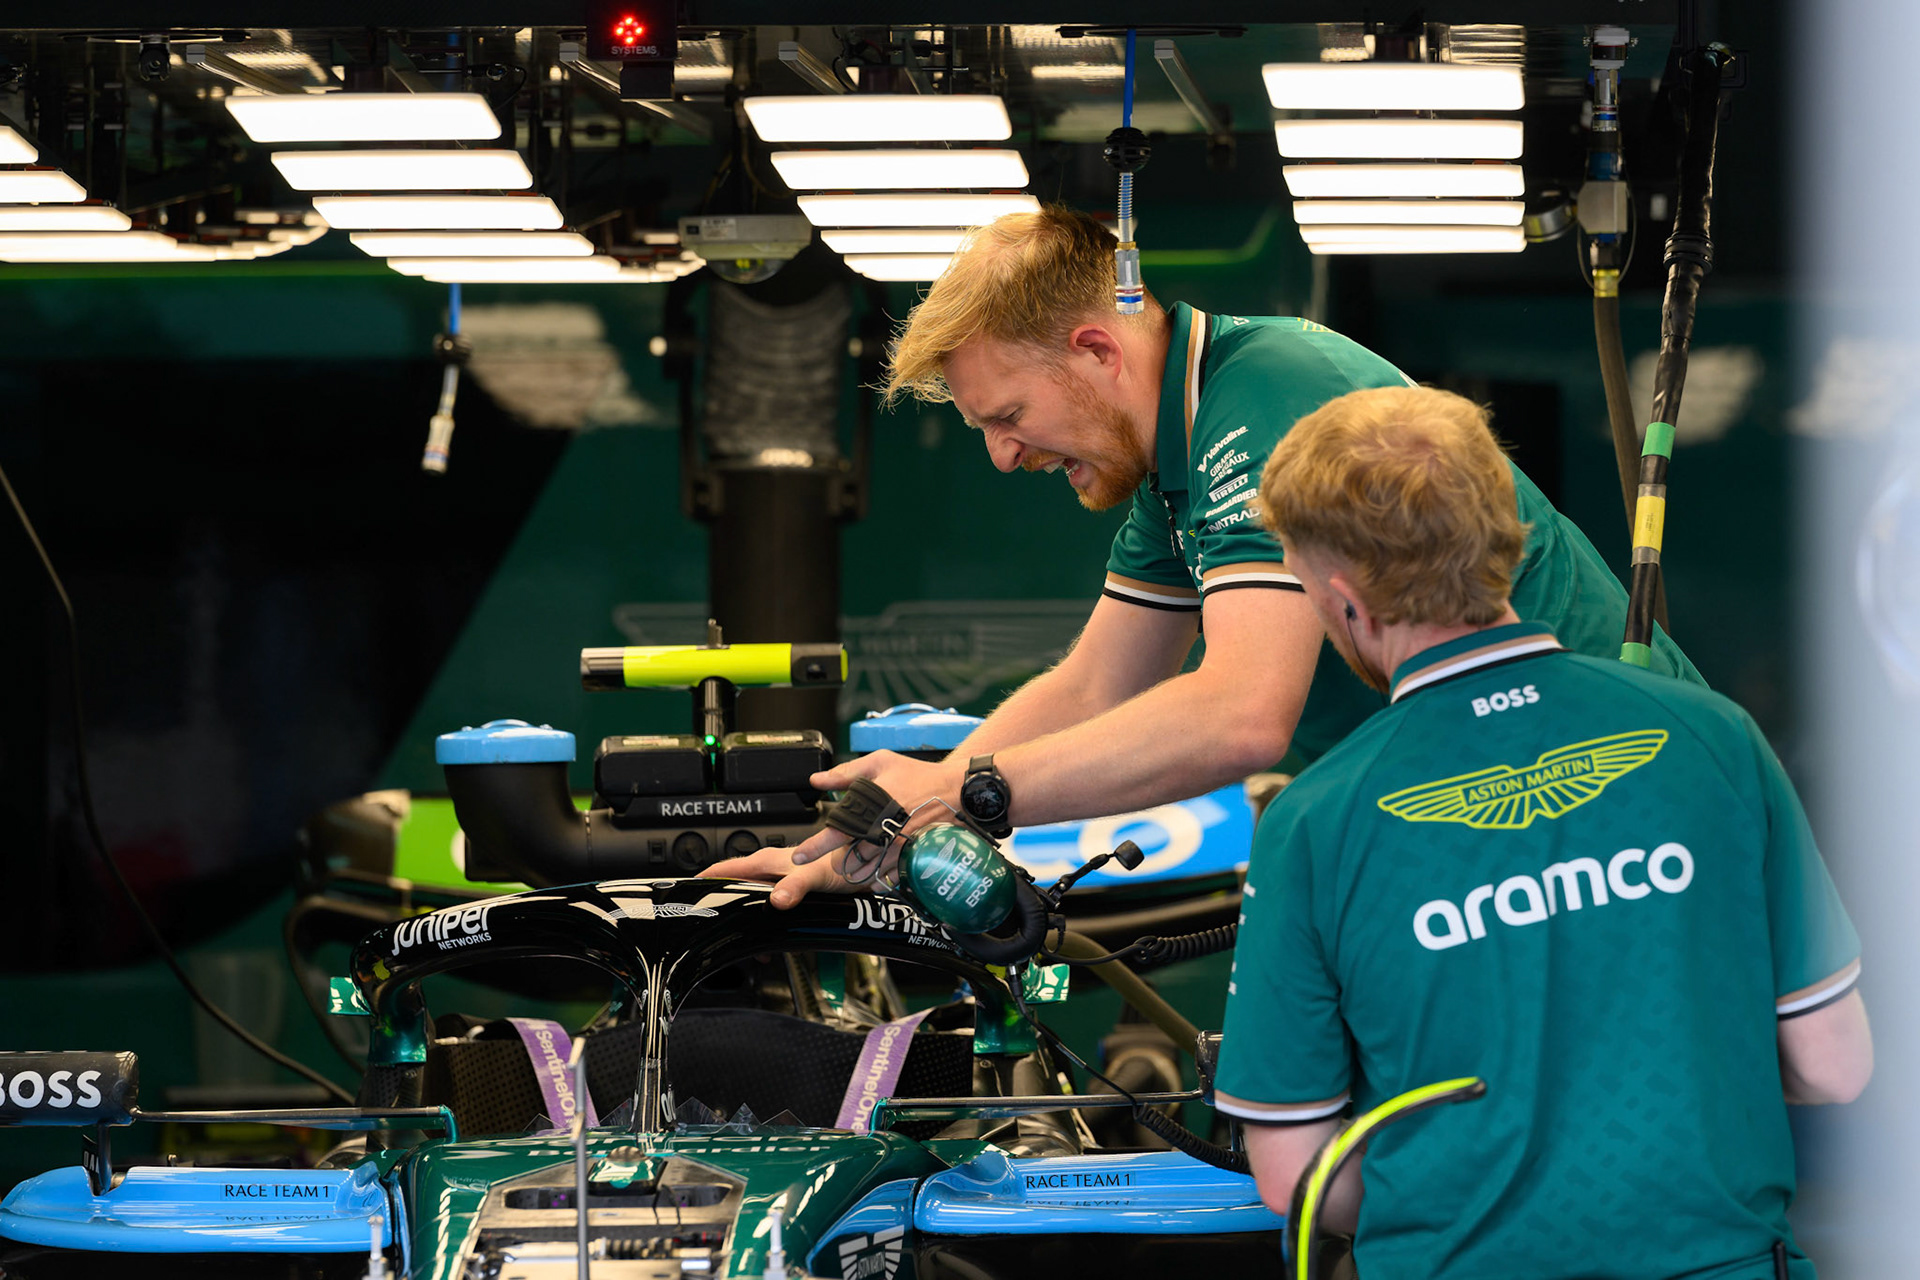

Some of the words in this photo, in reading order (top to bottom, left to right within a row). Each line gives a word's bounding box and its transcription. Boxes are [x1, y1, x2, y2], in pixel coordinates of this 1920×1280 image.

[611, 46, 657, 55] SYSTEMS
[1207, 426, 1248, 459] Valvoline
[1210, 449, 1235, 477] GIRARD
[1208, 474, 1248, 502] PIRELLI
[1471, 684, 1540, 717] BOSS
[1467, 776, 1524, 804] ASTON
[1526, 757, 1591, 790] MARTIN
[661, 802, 703, 816] RACE
[705, 800, 752, 815] TEAM
[754, 799, 761, 812] 1
[937, 850, 976, 896] aramco
[965, 876, 993, 907] EPOS
[1413, 842, 1694, 950] aramco
[438, 932, 492, 950] NETWORKS
[0, 1070, 102, 1109] OSS
[535, 1029, 578, 1124] SentinelO
[850, 1026, 901, 1131] SentinelOne
[225, 1184, 268, 1197] RACE
[272, 1184, 318, 1198] TEAM
[323, 1185, 329, 1198] 1
[1026, 1174, 1068, 1188] RACE
[1073, 1173, 1120, 1187] TEAM
[1124, 1173, 1131, 1186] 1
